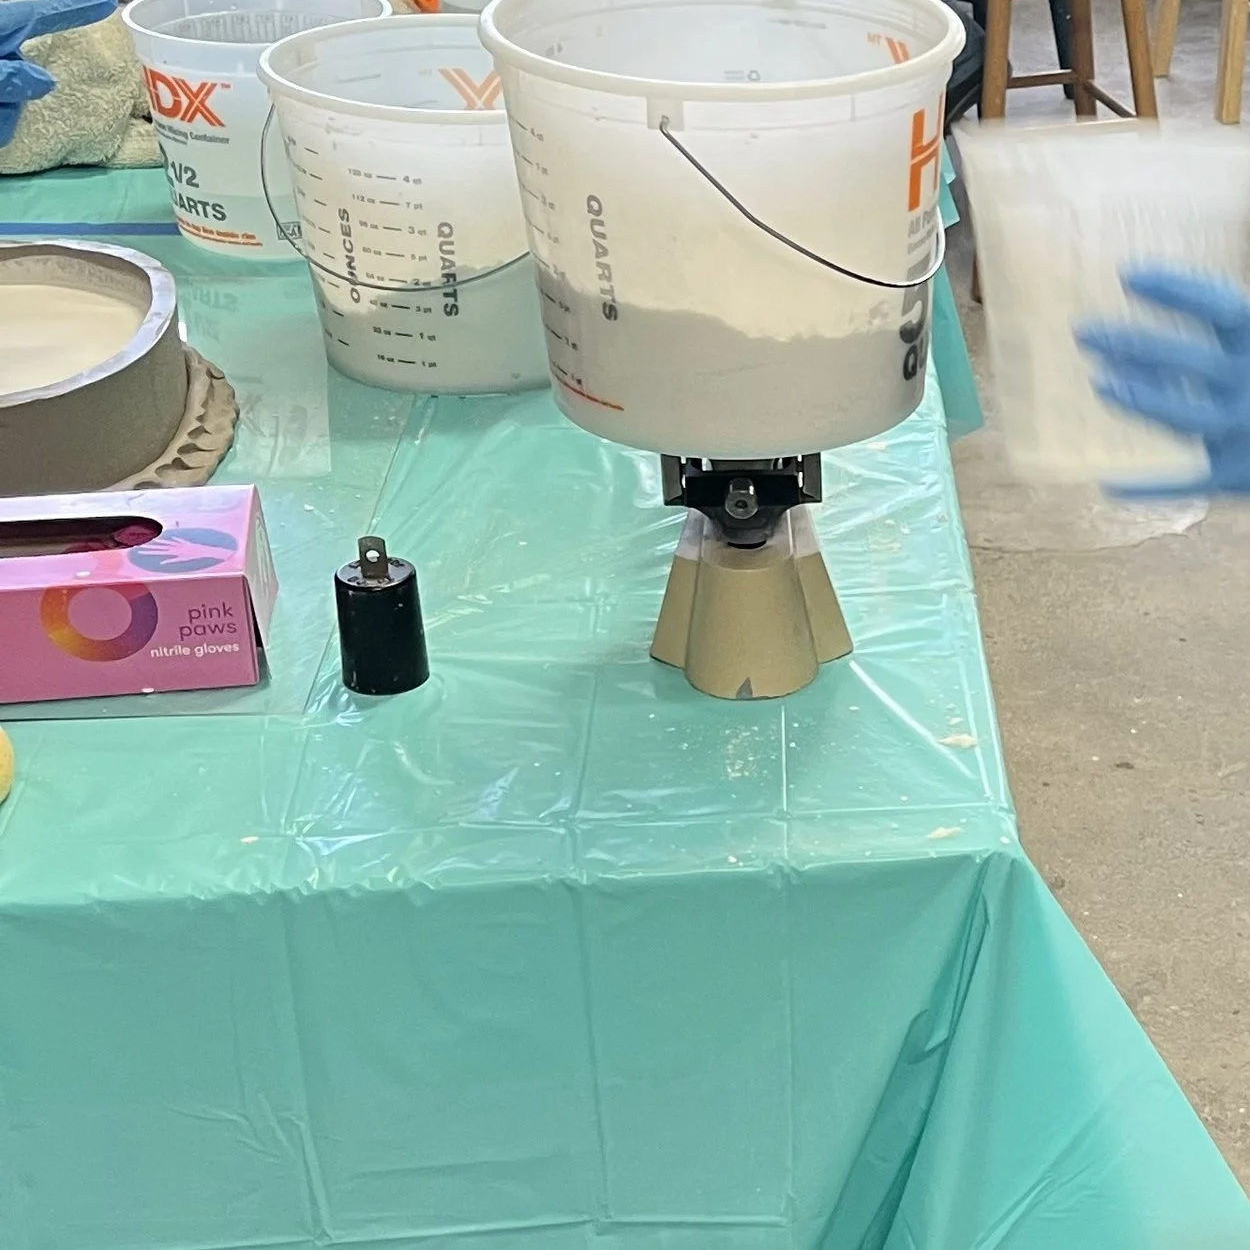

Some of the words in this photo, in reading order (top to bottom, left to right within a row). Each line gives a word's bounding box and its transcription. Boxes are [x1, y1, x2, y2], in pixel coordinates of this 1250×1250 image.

[437, 221, 460, 317] QUARTS
[586, 194, 618, 322] QUARTS
[187, 601, 234, 625] pink
[179, 622, 238, 642] paws
[150, 644, 191, 658] nitrile
[194, 642, 240, 658] gloves
